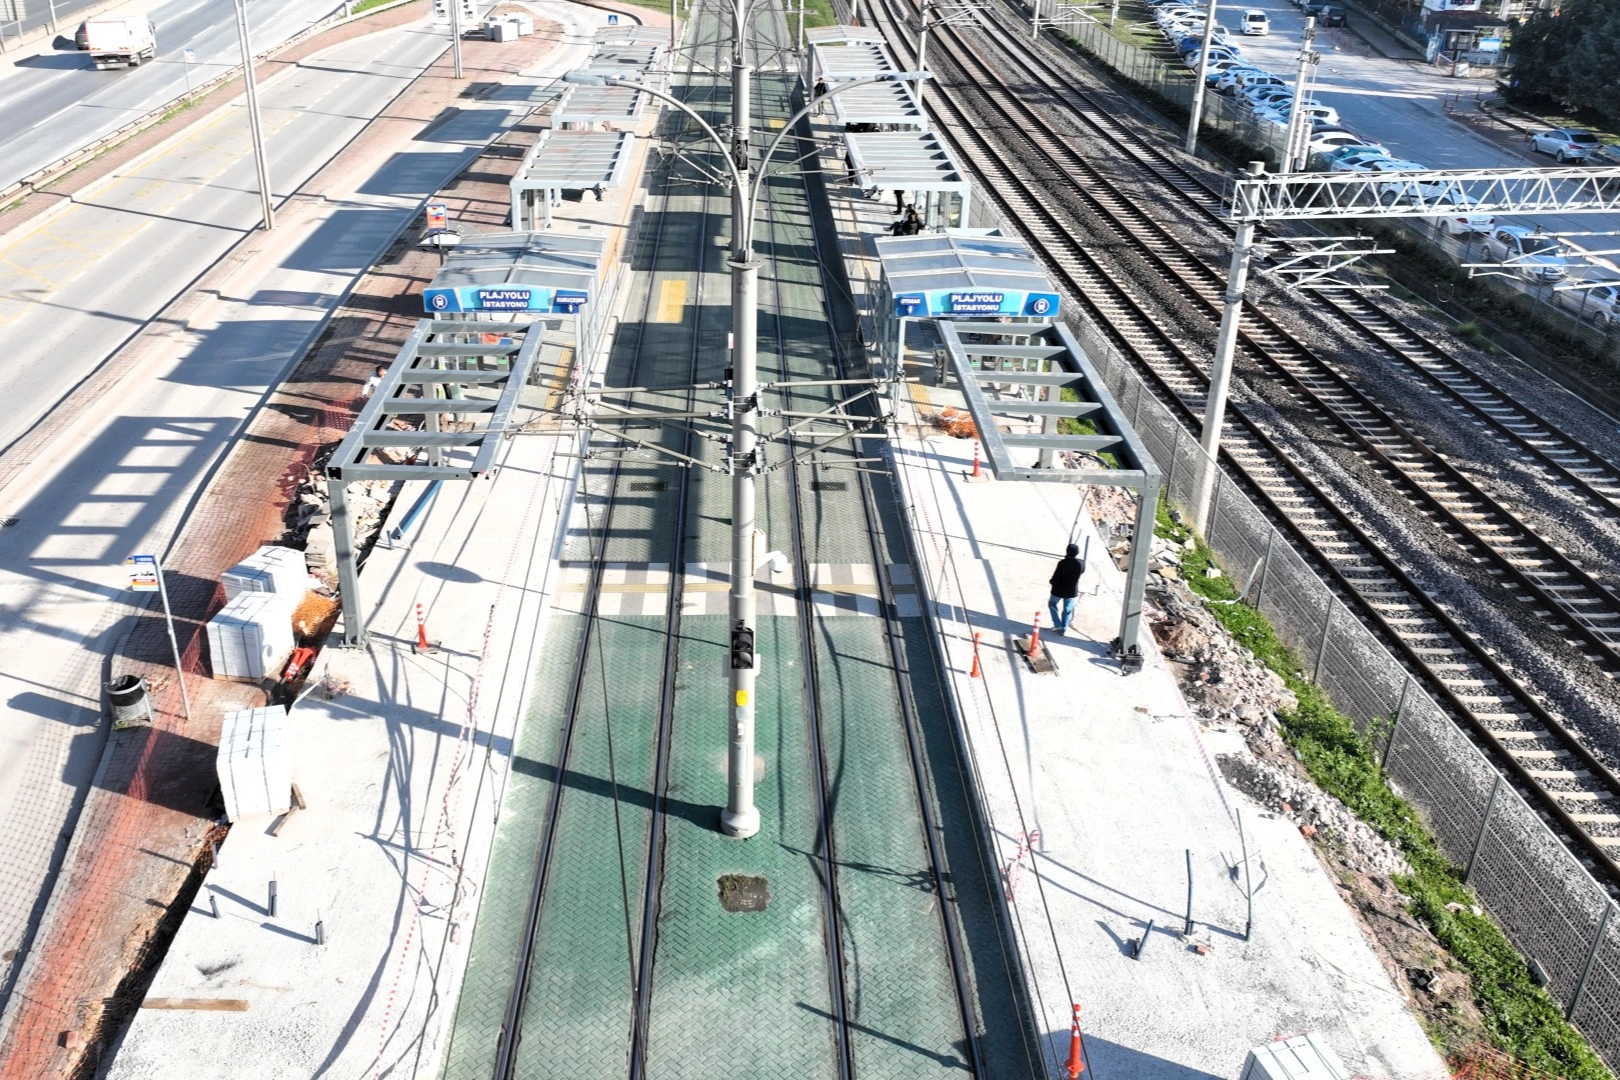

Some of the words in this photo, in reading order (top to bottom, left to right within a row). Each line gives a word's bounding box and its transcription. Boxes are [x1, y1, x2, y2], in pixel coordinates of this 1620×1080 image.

[480, 291, 530, 300] PLAJYOLU
[951, 294, 1003, 303] PLAJYOLU
[483, 300, 528, 308] İSTASYONU
[953, 303, 999, 311] İSTASYONU
